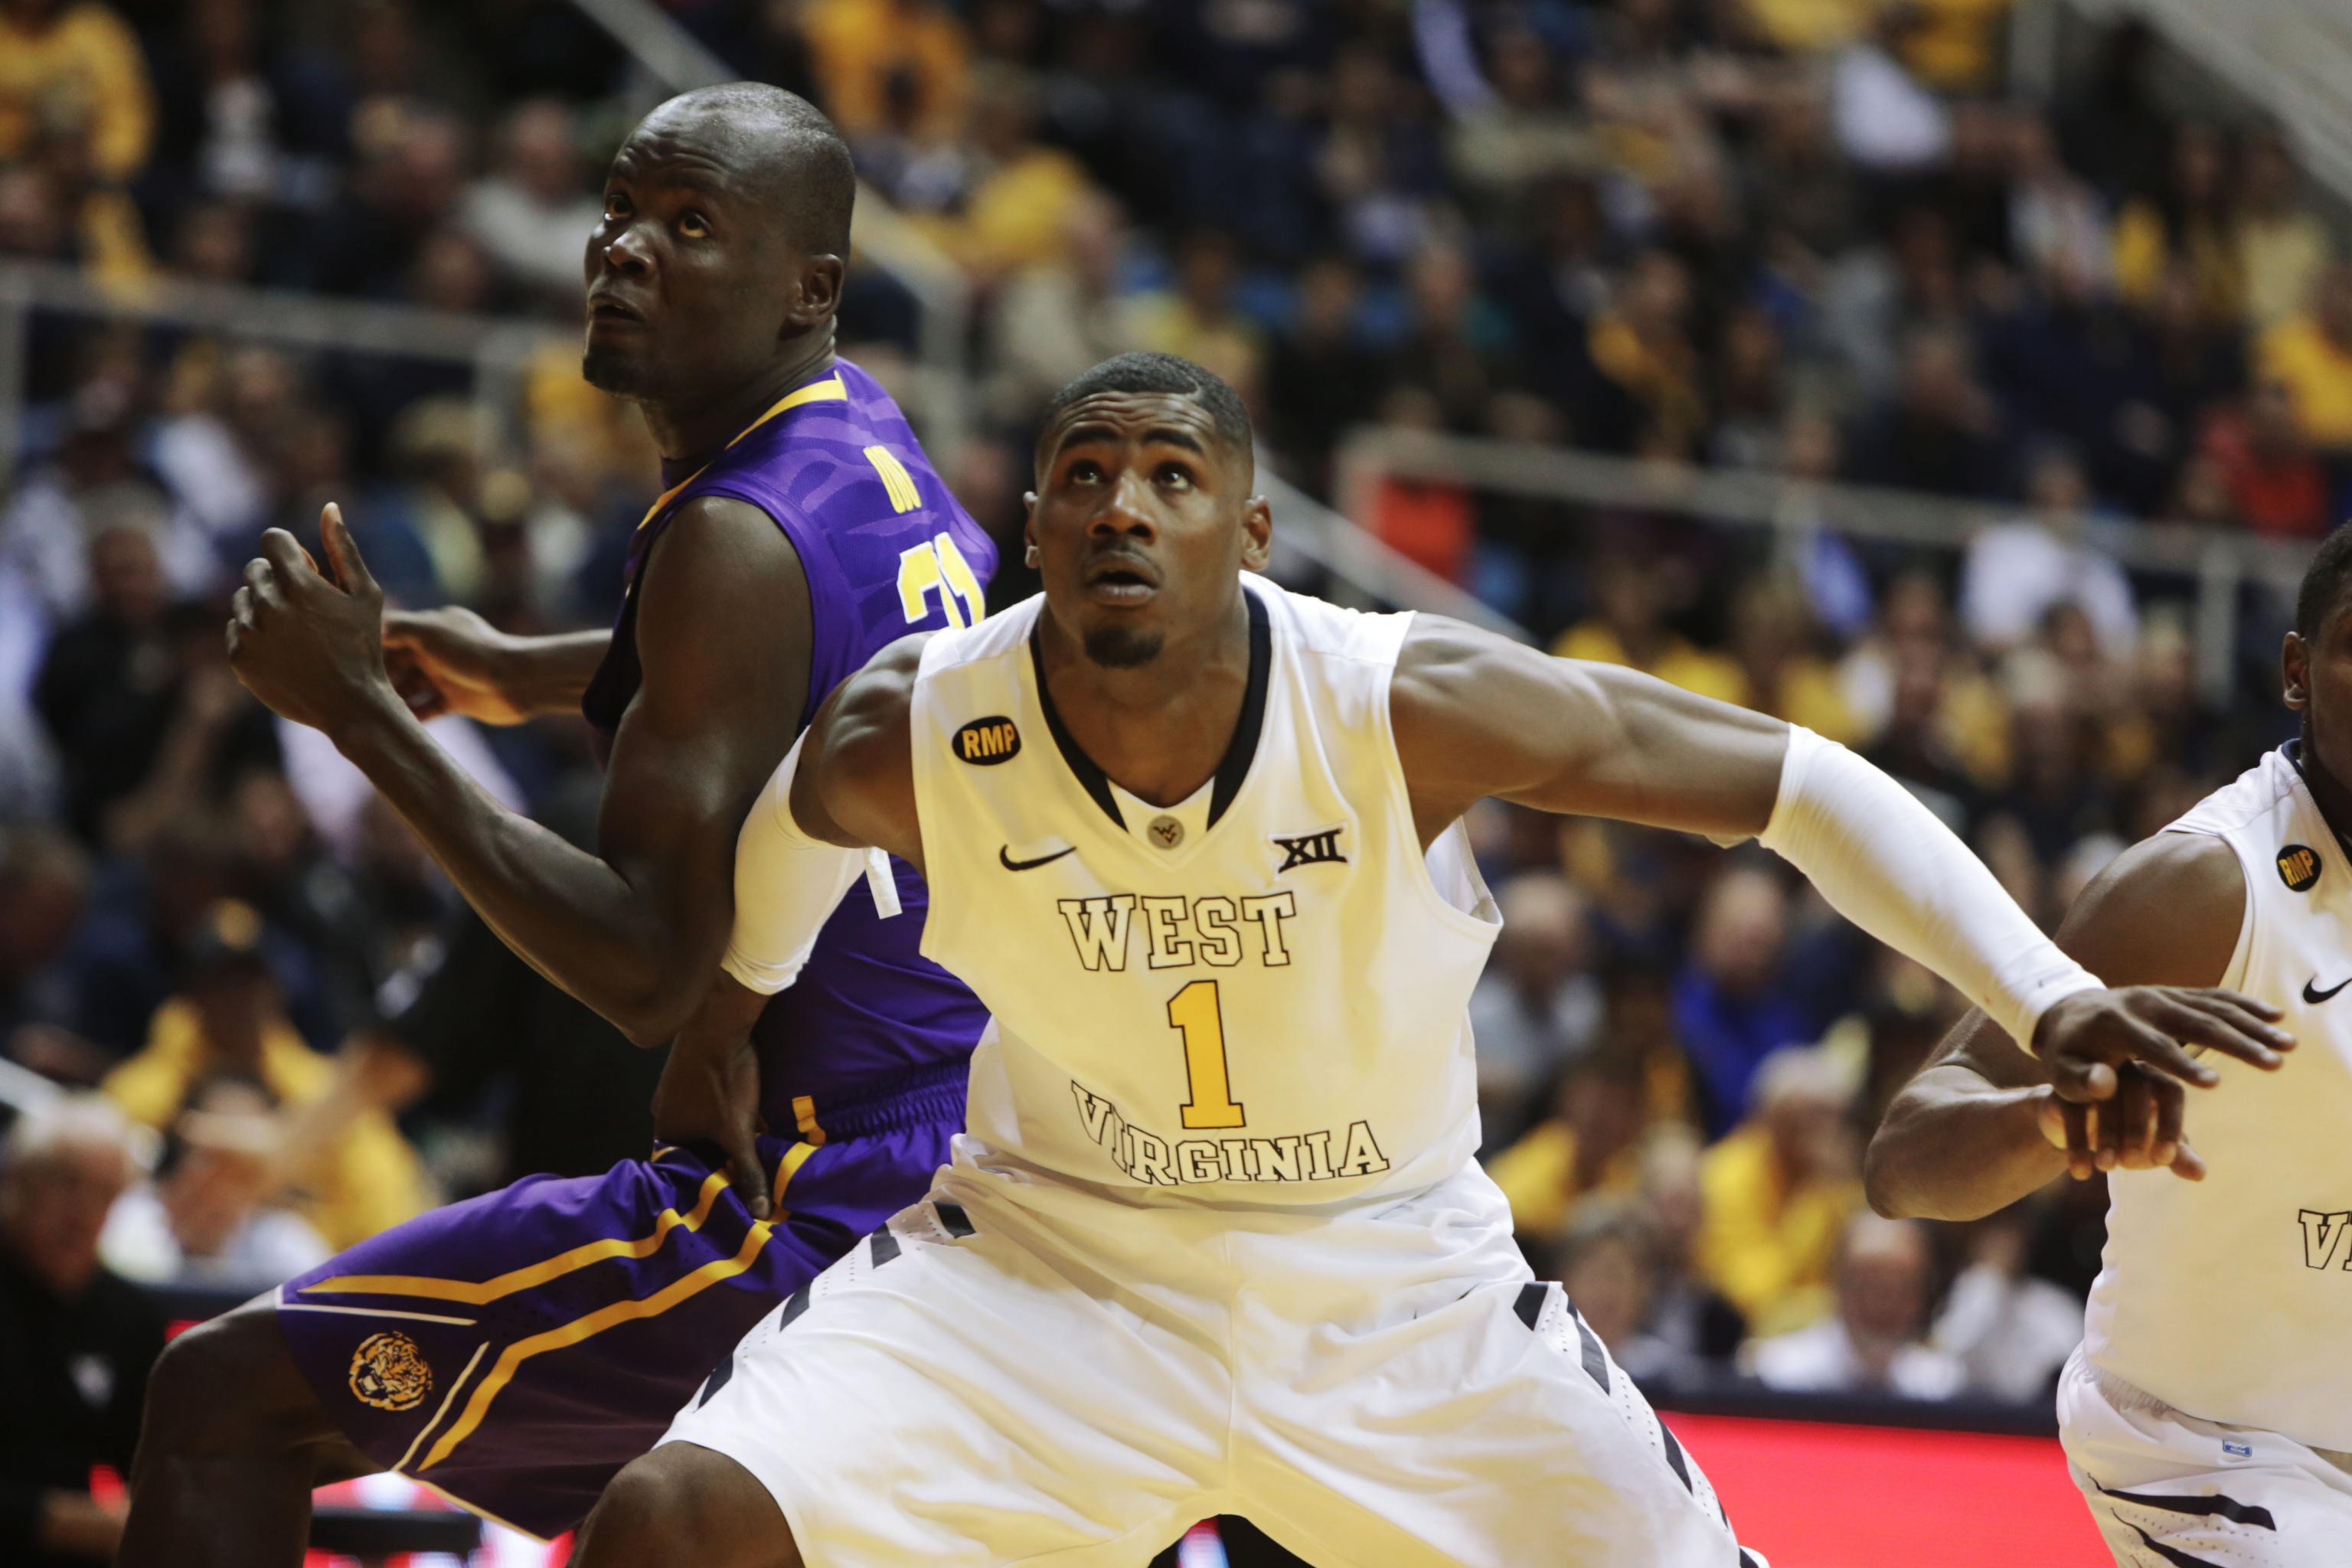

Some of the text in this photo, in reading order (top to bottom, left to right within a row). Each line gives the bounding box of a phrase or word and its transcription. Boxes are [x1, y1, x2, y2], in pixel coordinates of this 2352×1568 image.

[962, 723, 1015, 759] RMP
[1272, 828, 1348, 874] XII
[2278, 849, 2314, 887] RMP
[1057, 890, 1296, 972] WEST
[1167, 979, 1246, 1129] 1
[1071, 1080, 1390, 1186] VIRGINIA
